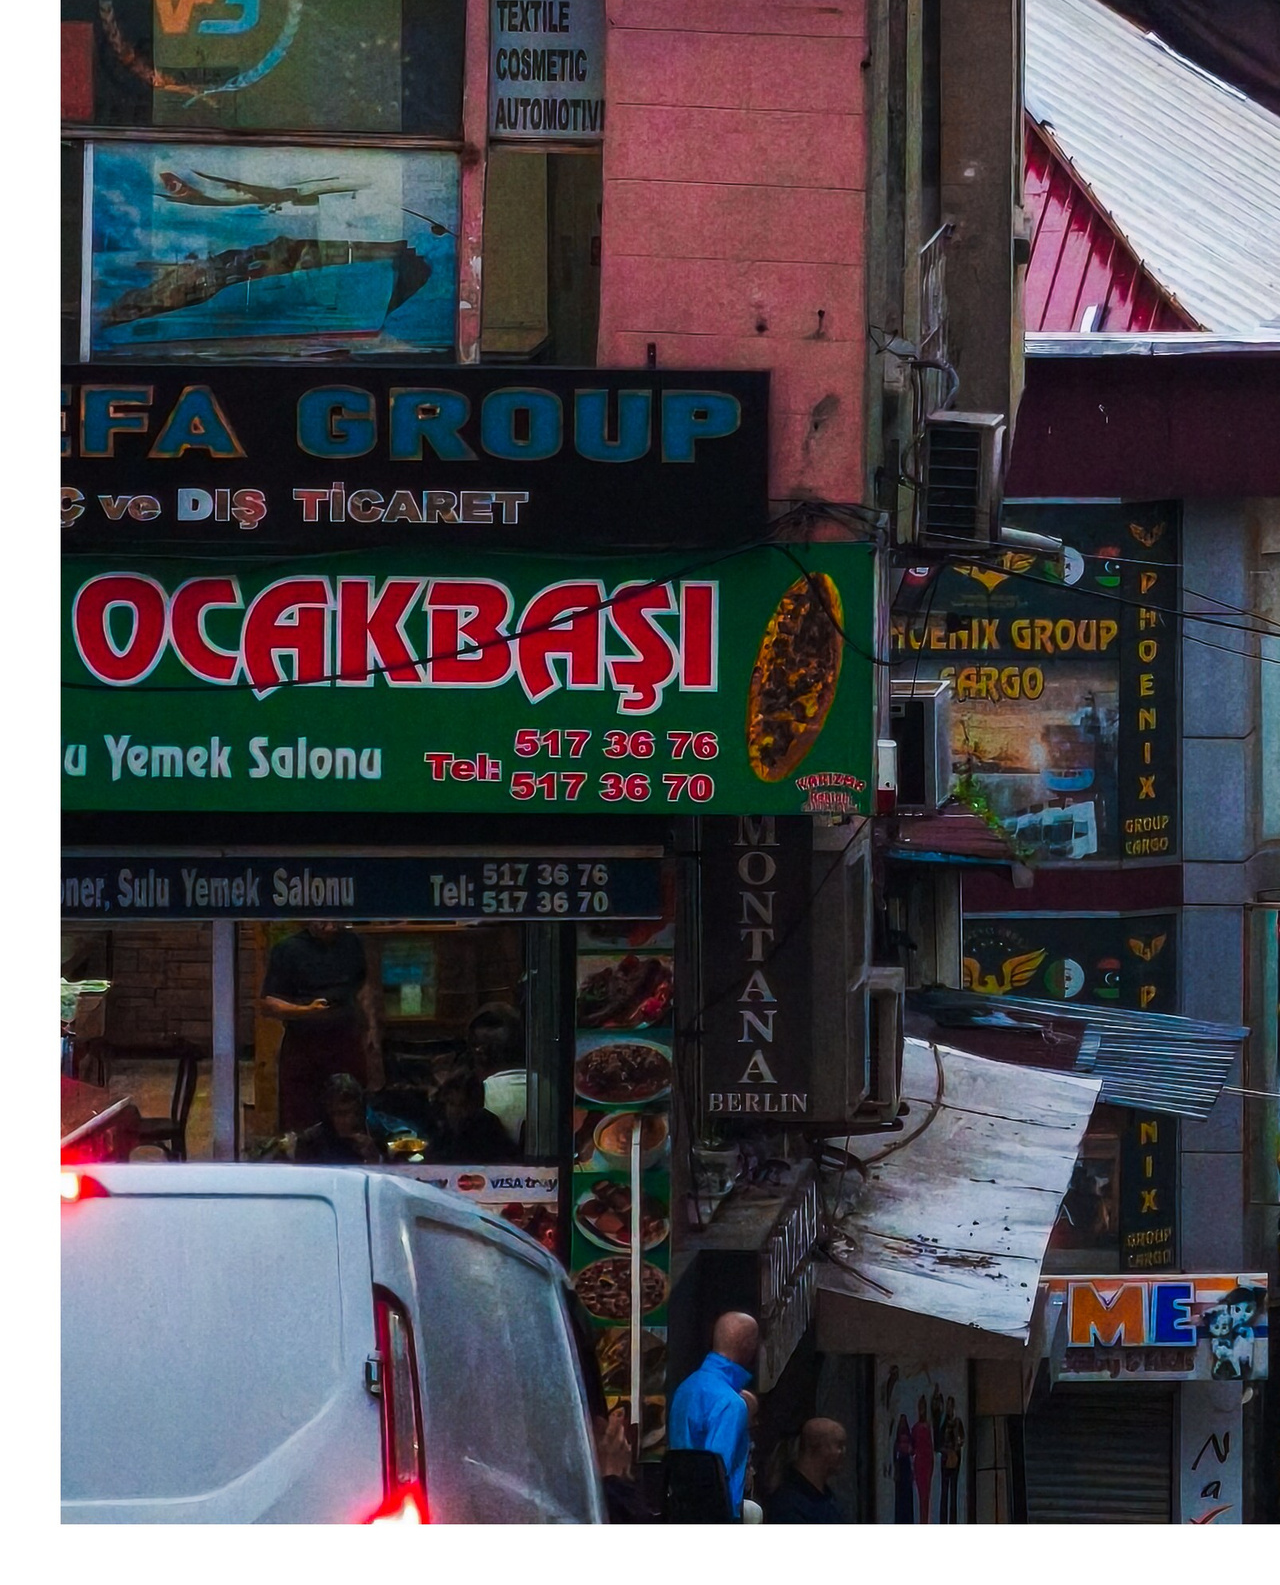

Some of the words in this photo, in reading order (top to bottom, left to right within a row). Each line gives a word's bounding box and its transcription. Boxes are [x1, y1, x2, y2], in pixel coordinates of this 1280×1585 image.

[496, 0, 571, 33] TEXTILE
[495, 48, 588, 82] COSMETIC
[297, 384, 742, 463] GROUP
[98, 494, 162, 522] ve
[177, 487, 268, 530] DIŞ
[292, 482, 530, 524] TİCARET
[73, 572, 720, 716] OCAKBAŞI
[1010, 618, 1118, 654] GROUP
[1138, 570, 1159, 800] PHOENIX
[103, 733, 233, 782] Yemek
[248, 736, 382, 780] Salonu
[514, 729, 592, 758] 517
[602, 730, 656, 759] 36
[666, 731, 720, 760] 76
[424, 752, 502, 782] Tel:
[509, 771, 588, 801] 517
[599, 772, 652, 802] 36
[662, 773, 716, 803] 70
[1125, 815, 1169, 833] GROUP
[1125, 835, 1169, 854] CARGO
[117, 868, 170, 908] Sulu
[181, 868, 261, 908] Yemek
[272, 867, 355, 908] Salonu
[429, 875, 475, 907] Tel:
[482, 863, 529, 886] 517
[536, 864, 570, 886] 36
[577, 864, 609, 886] 76
[481, 891, 529, 913] 517
[536, 891, 570, 913] 36
[577, 891, 610, 913] 70
[730, 815, 780, 1084] MONTANA
[708, 1093, 808, 1114] BERLIN
[1067, 1281, 1197, 1348] ME
